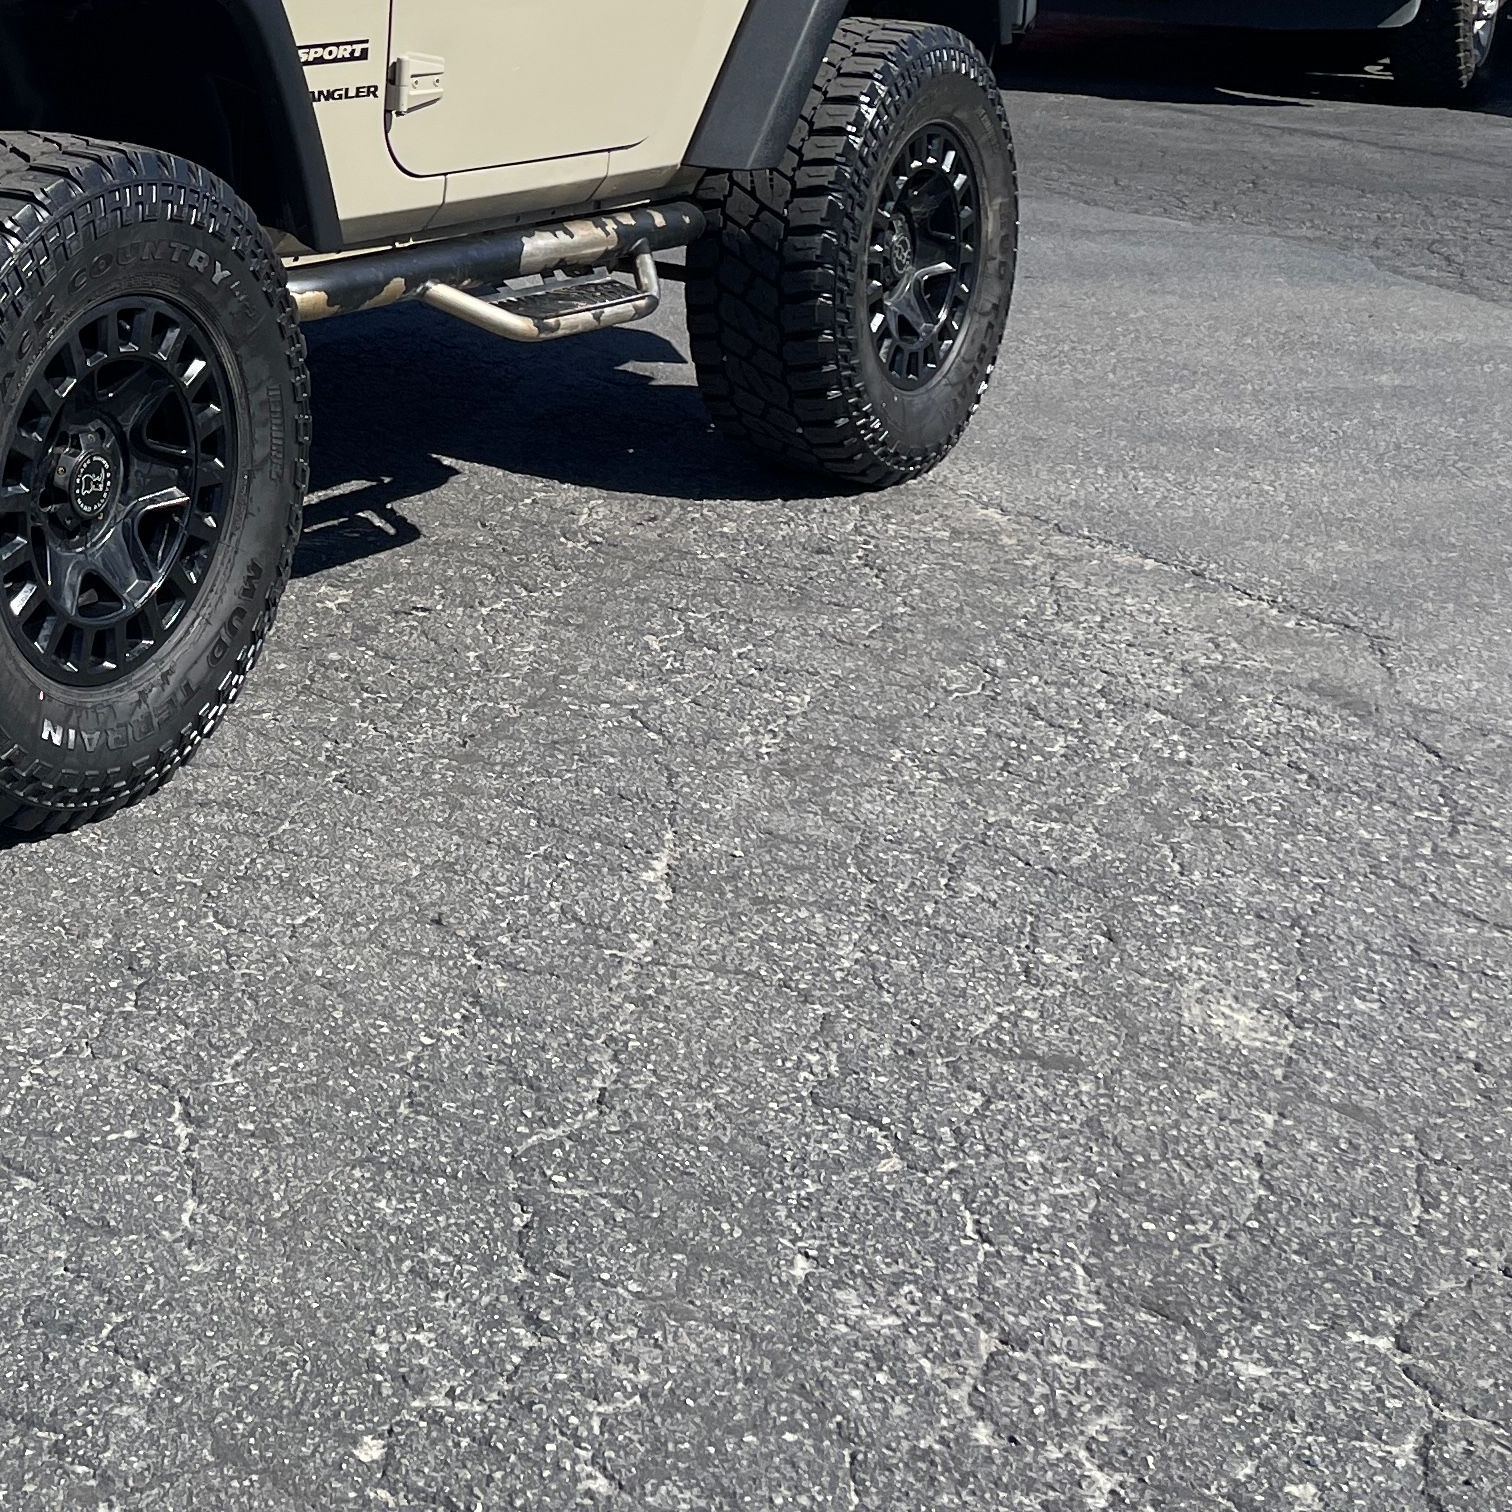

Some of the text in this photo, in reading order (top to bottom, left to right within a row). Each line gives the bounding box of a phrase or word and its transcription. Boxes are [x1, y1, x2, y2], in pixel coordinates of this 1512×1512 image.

[297, 43, 370, 63] SPORT
[68, 239, 233, 287] COUNTRY
[41, 557, 265, 752] MUD TERRAIN
